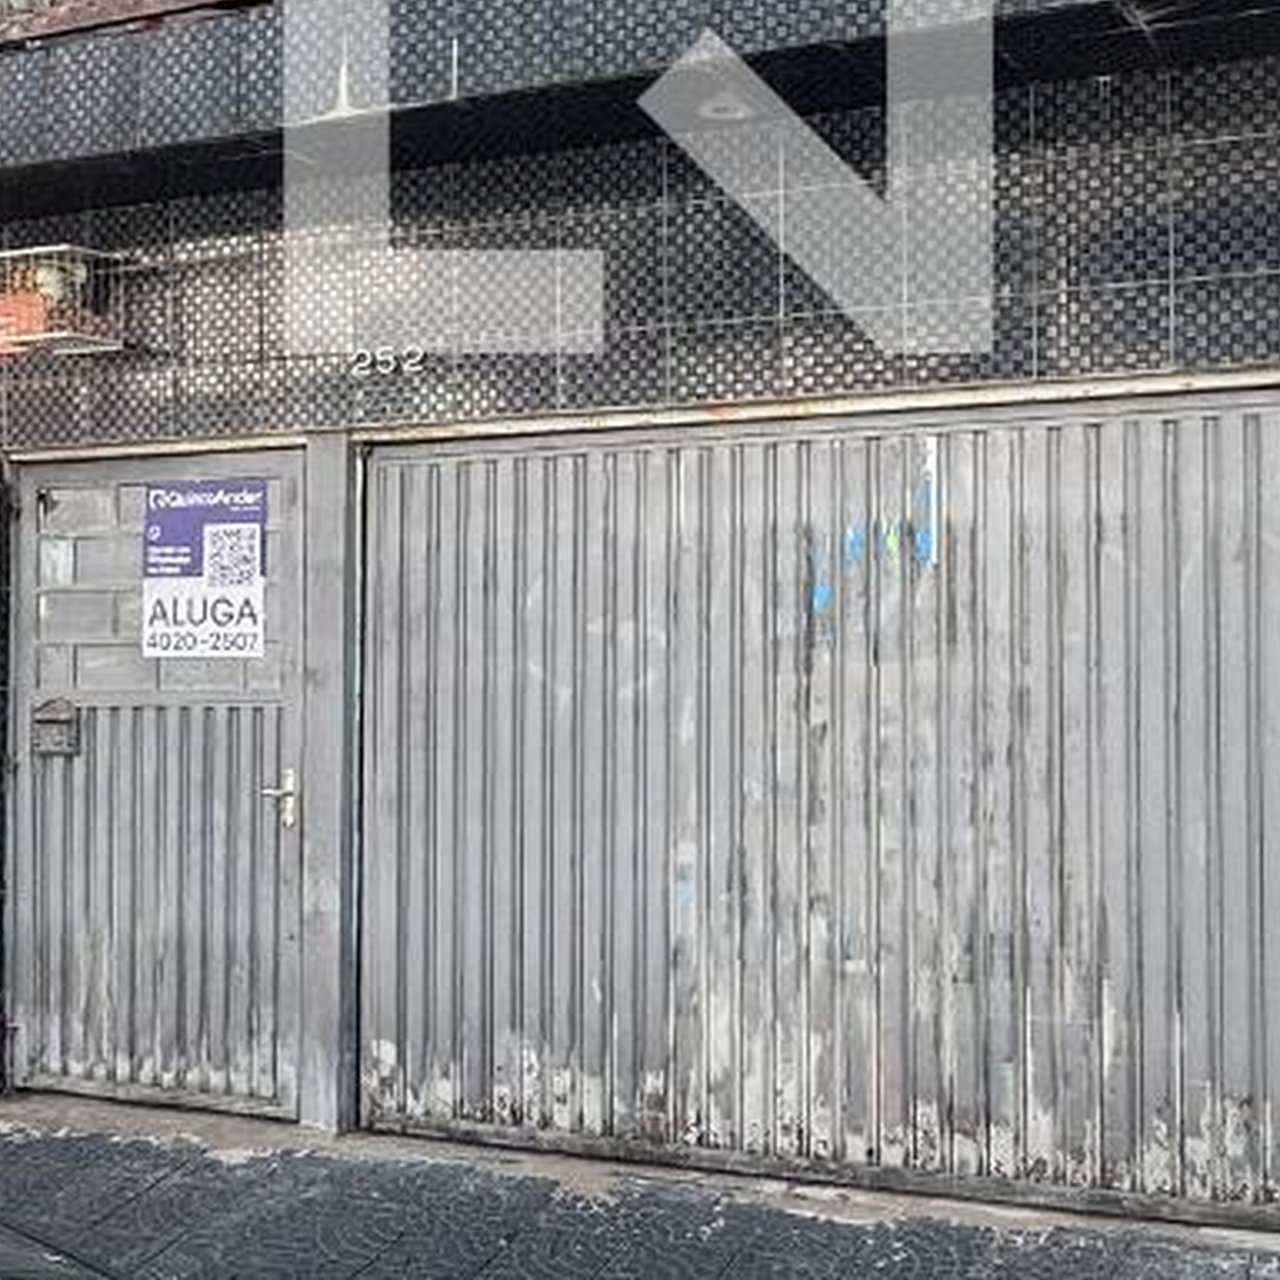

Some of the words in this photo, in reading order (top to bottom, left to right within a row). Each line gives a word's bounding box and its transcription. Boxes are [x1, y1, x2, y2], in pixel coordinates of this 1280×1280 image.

[351, 346, 425, 376] 252
[149, 598, 258, 627] ALUGA
[147, 633, 258, 651] 4020-2507
